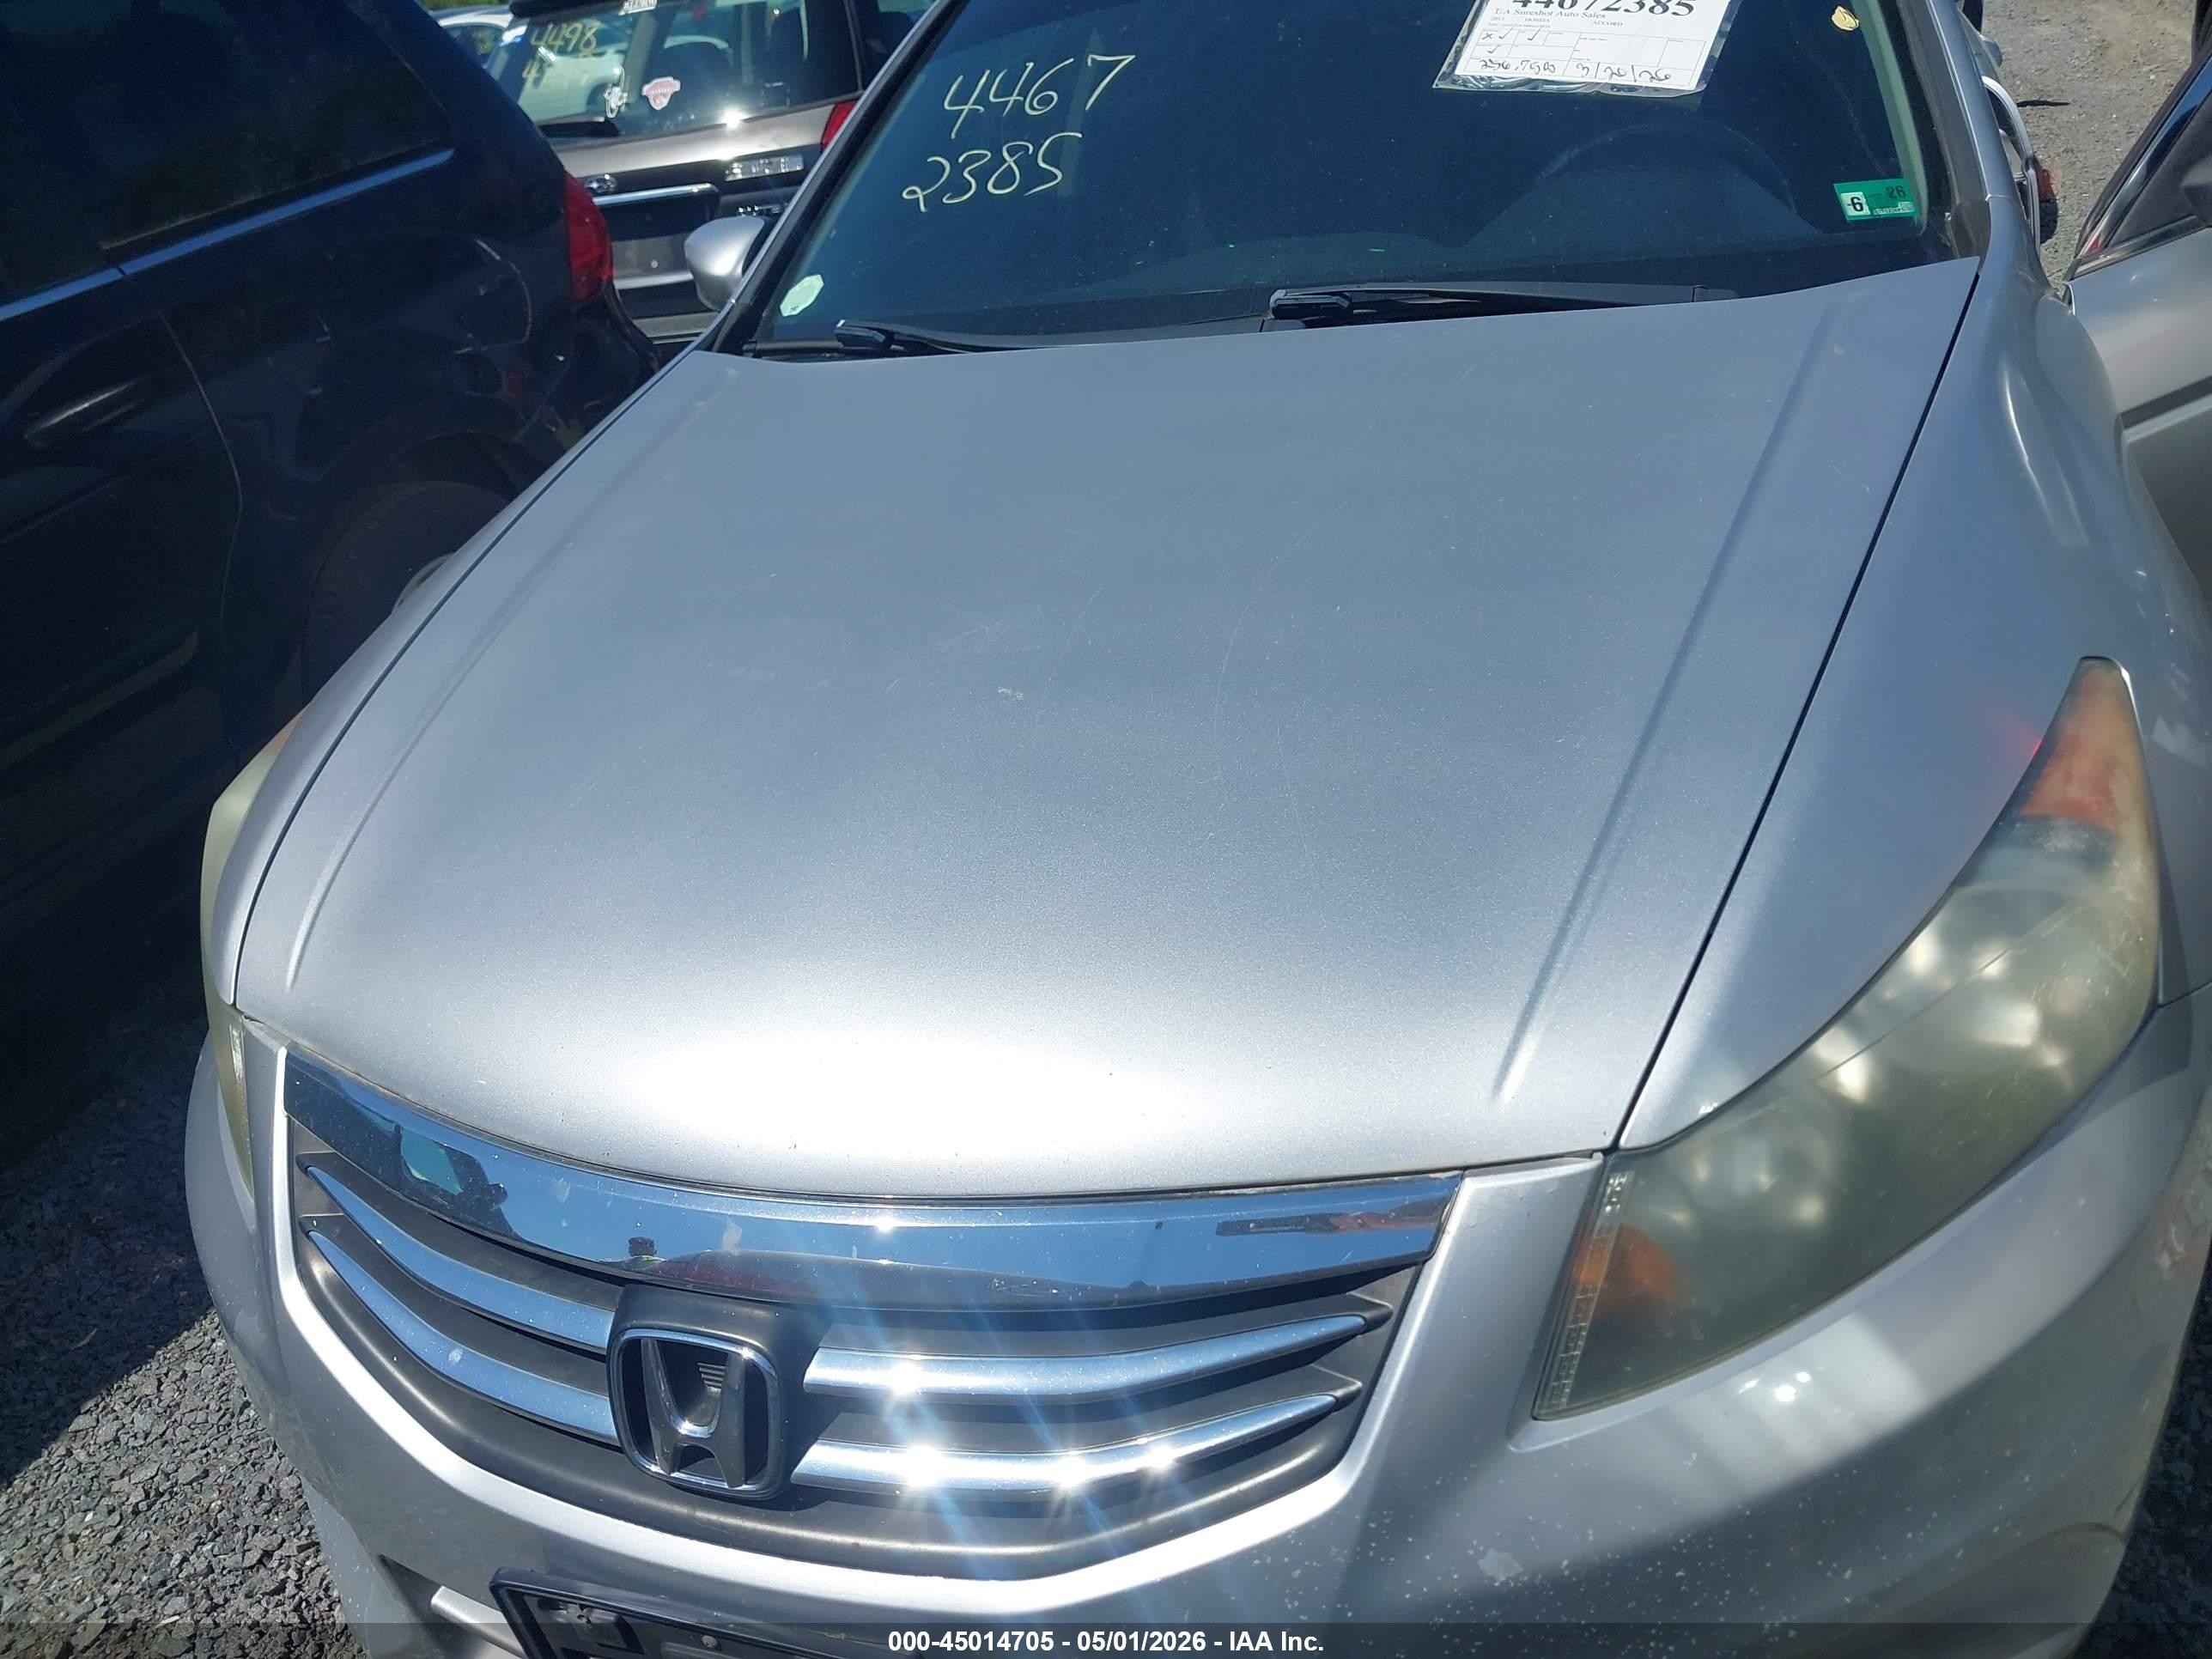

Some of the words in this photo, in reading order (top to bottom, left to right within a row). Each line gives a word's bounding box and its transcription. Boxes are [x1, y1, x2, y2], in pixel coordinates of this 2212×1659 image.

[943, 53, 1137, 140] 4467
[901, 131, 1084, 213] 2385
[1886, 185, 1906, 198] 26
